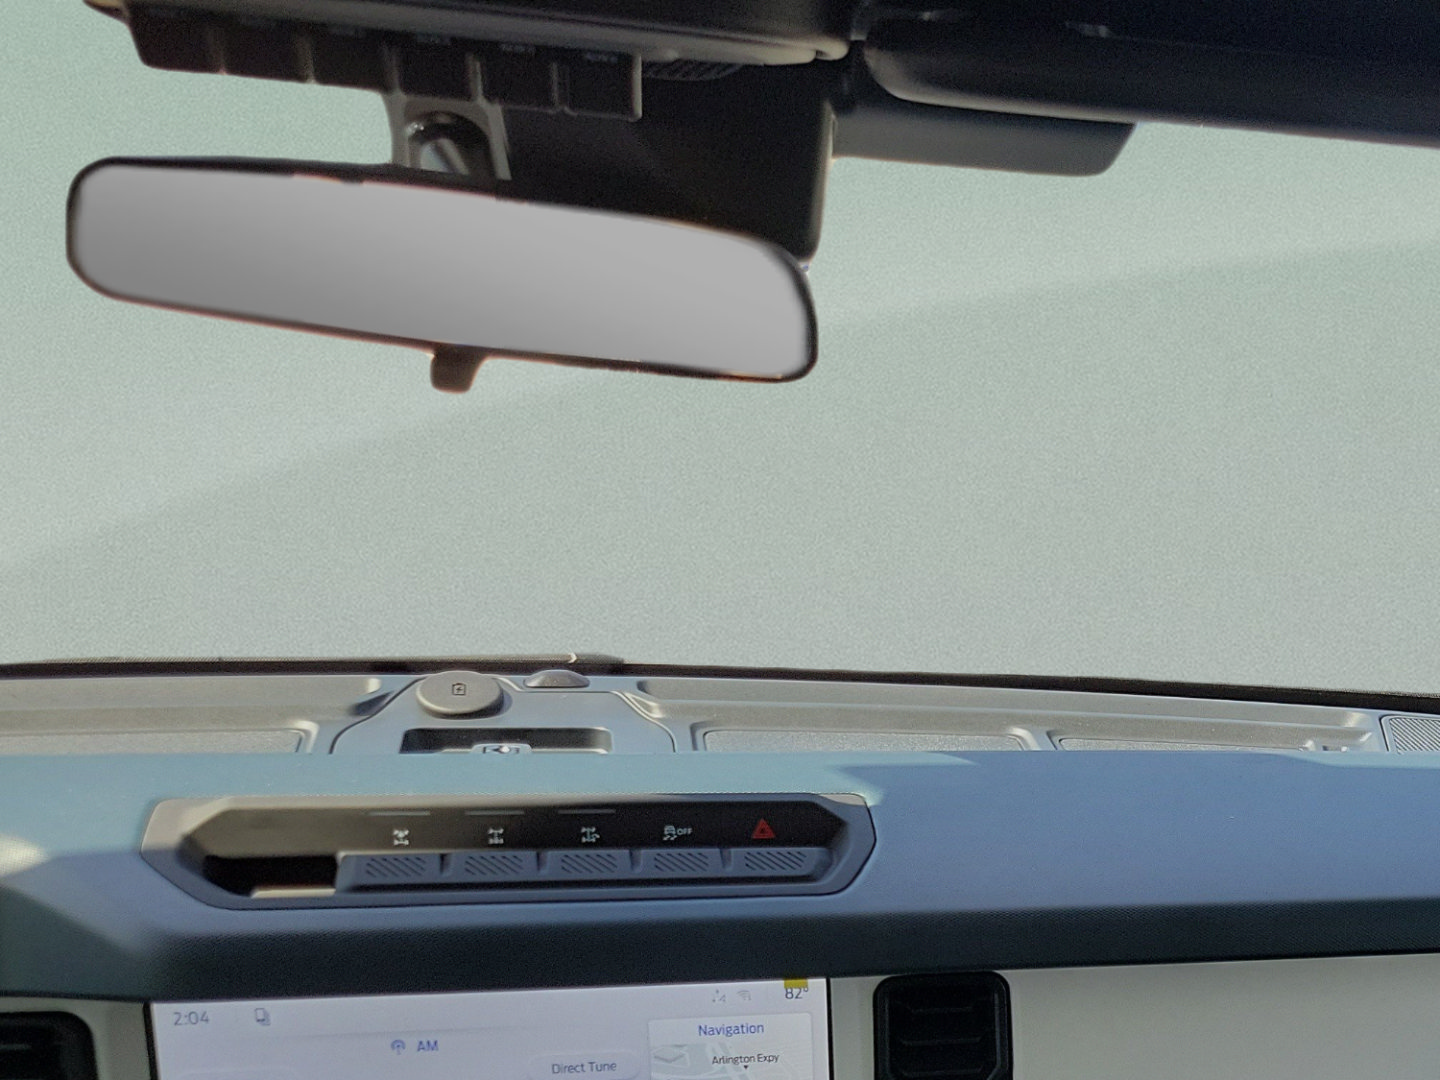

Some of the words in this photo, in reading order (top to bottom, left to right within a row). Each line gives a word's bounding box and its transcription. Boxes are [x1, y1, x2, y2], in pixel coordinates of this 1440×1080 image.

[676, 827, 693, 835] OFF
[173, 1011, 210, 1026] 2:04
[698, 1022, 765, 1038] Navigation
[416, 1040, 439, 1051] AM
[711, 1054, 756, 1066] Arlington
[757, 1053, 780, 1066] Expy
[551, 1062, 585, 1075] Direct
[585, 1060, 617, 1073] Tune
